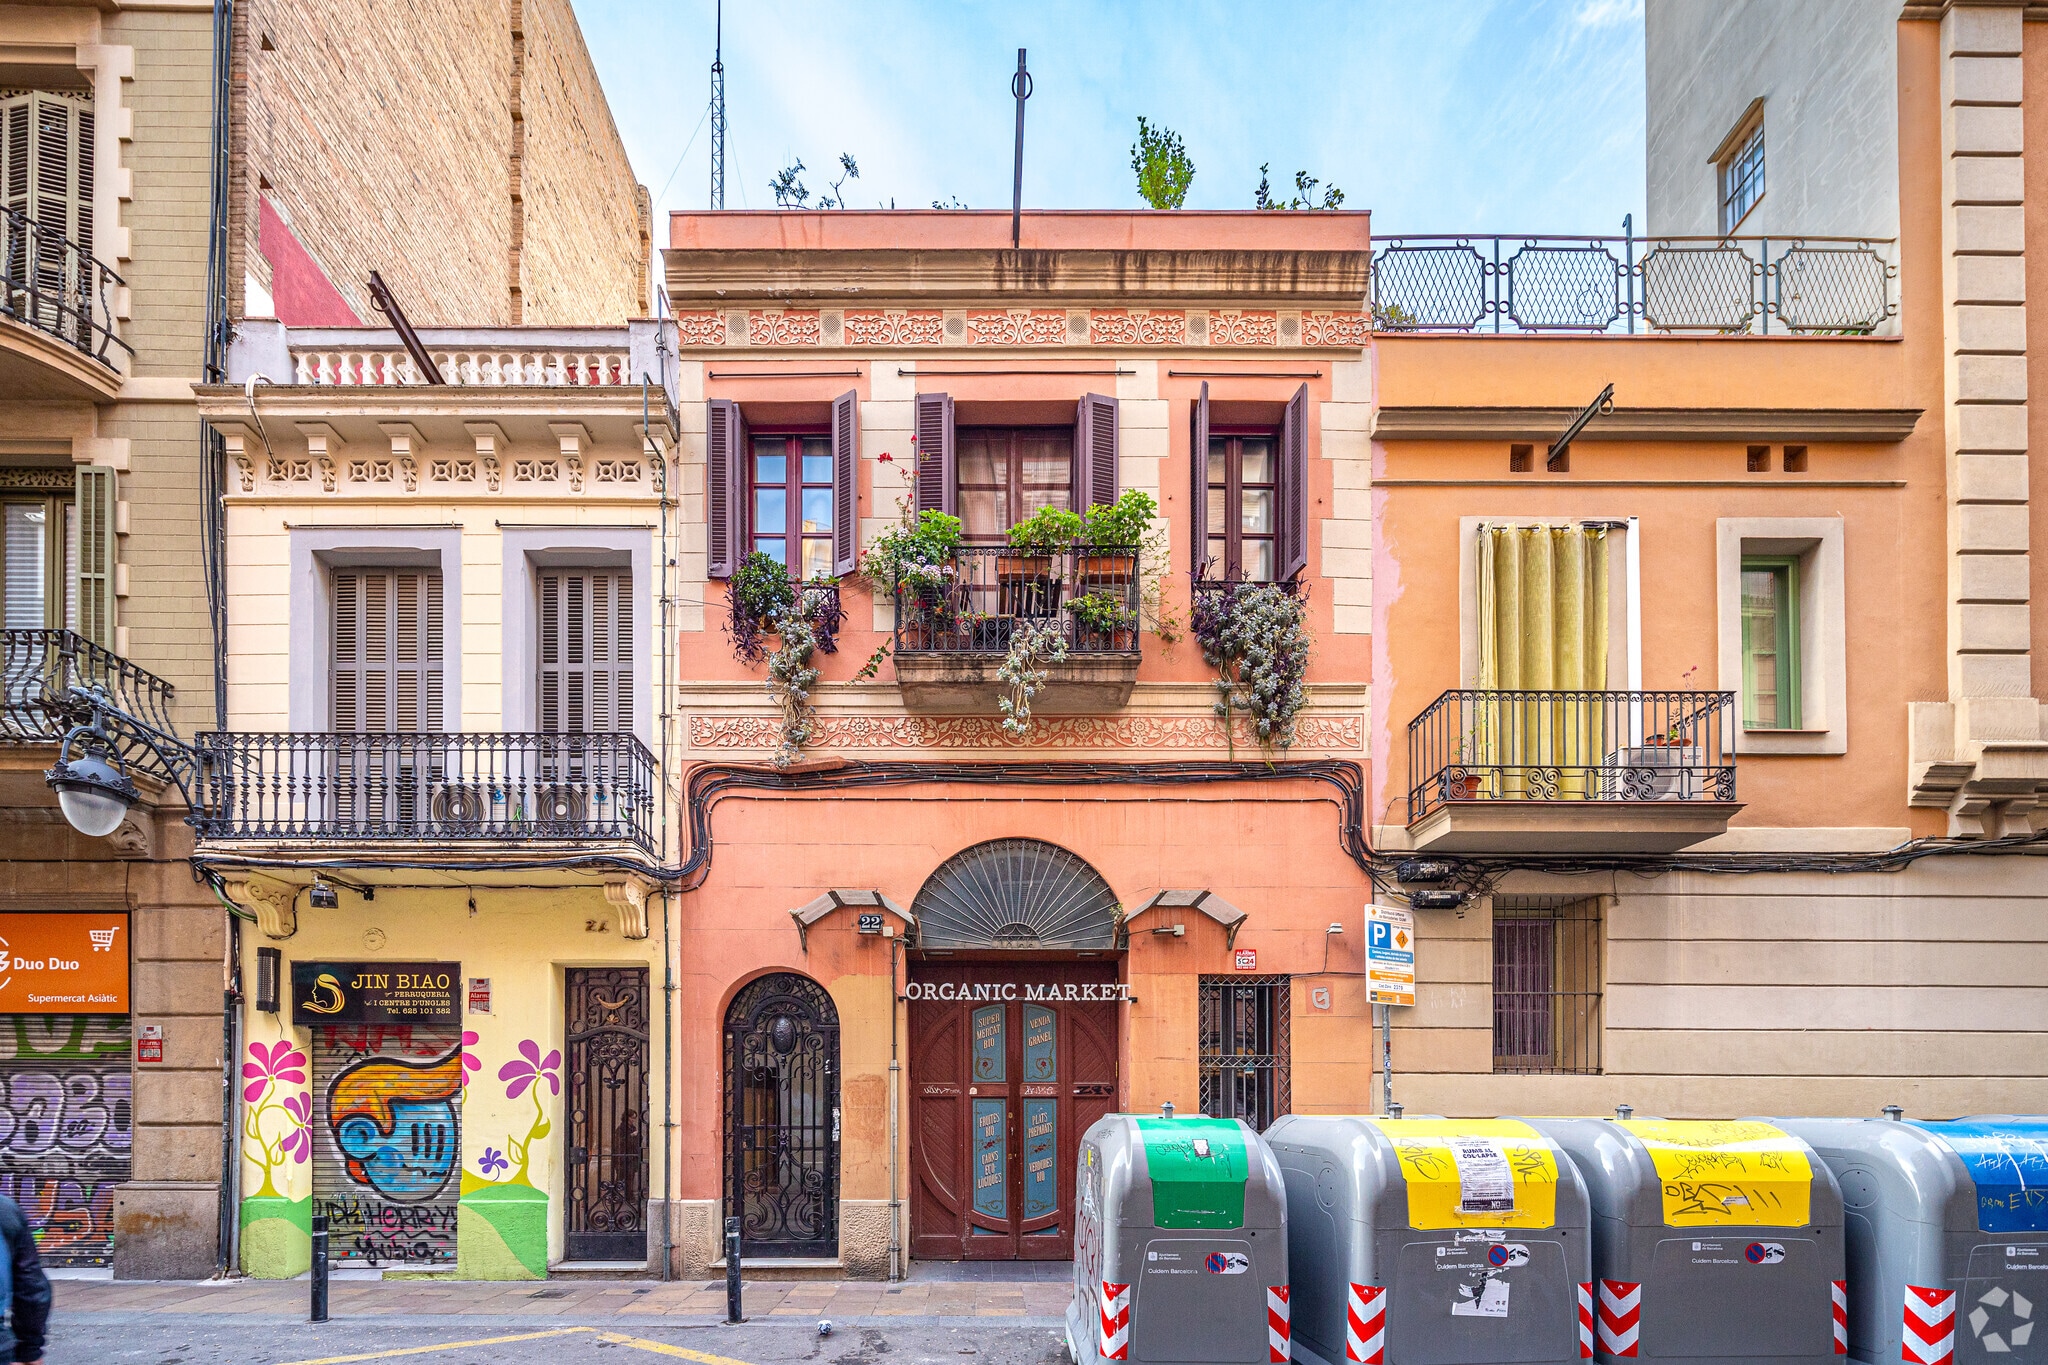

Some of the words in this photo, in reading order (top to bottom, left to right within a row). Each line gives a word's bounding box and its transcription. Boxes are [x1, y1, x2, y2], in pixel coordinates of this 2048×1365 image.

[861, 916, 880, 928] 22
[1373, 923, 1386, 945] P
[13, 957, 45, 970] Duo
[48, 957, 79, 970] Duo
[351, 974, 390, 989] JIN
[396, 974, 450, 989] BIAO
[905, 983, 1016, 1000] ORGANIC
[1025, 983, 1131, 1001] MARKET
[28, 994, 85, 1004] Supermercat
[87, 994, 118, 1003] Asiàtic
[978, 1013, 1000, 1027] SUPER
[1029, 1015, 1051, 1029] VENDA
[976, 1024, 1001, 1040] MERCAT
[983, 1038, 995, 1049] BIO
[1028, 1031, 1052, 1047] GRANEL
[1031, 1112, 1048, 1125] PLATS
[985, 1125, 995, 1138] BIO
[1036, 1171, 1046, 1183] BIO
